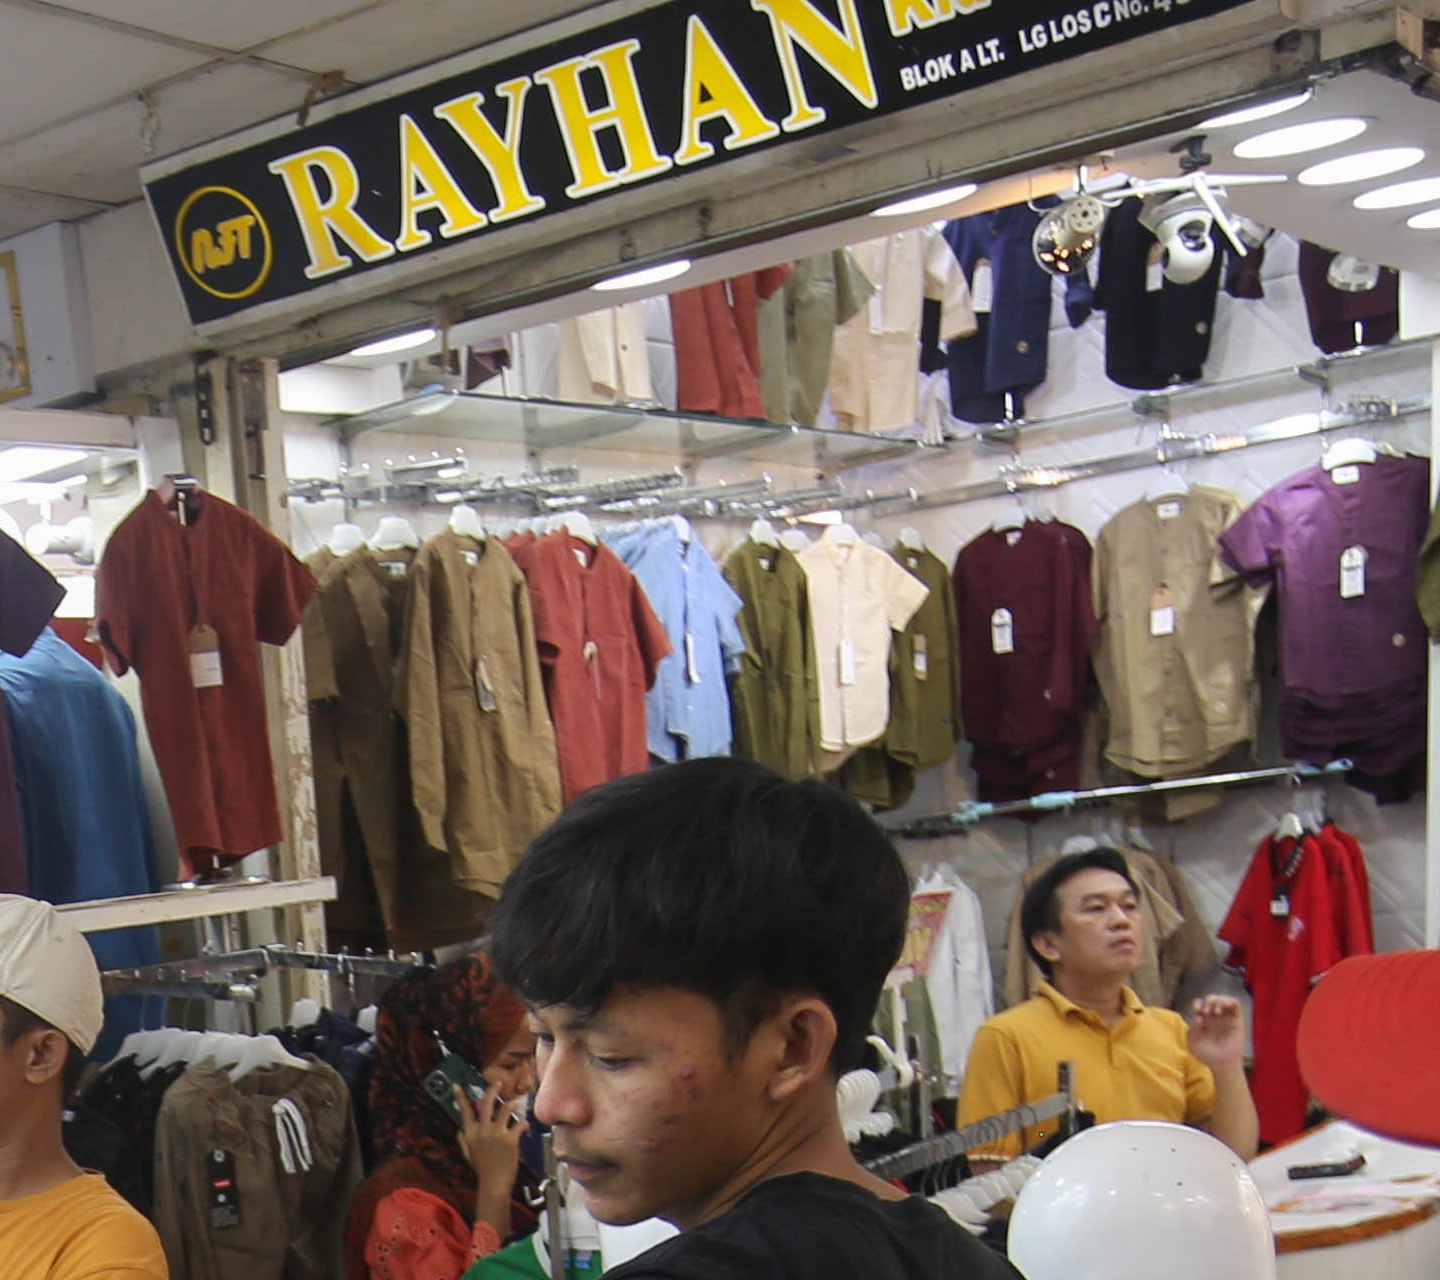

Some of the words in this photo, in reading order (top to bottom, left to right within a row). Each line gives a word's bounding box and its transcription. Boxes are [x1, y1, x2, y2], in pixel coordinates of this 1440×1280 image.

[900, 53, 956, 91] BLOK
[960, 48, 975, 73] A
[976, 38, 1005, 67] LT.
[1018, 24, 1048, 53] LG
[1049, 9, 1092, 43] LOS
[1093, 2, 1112, 29] C
[267, 0, 879, 280] RAYHAN
